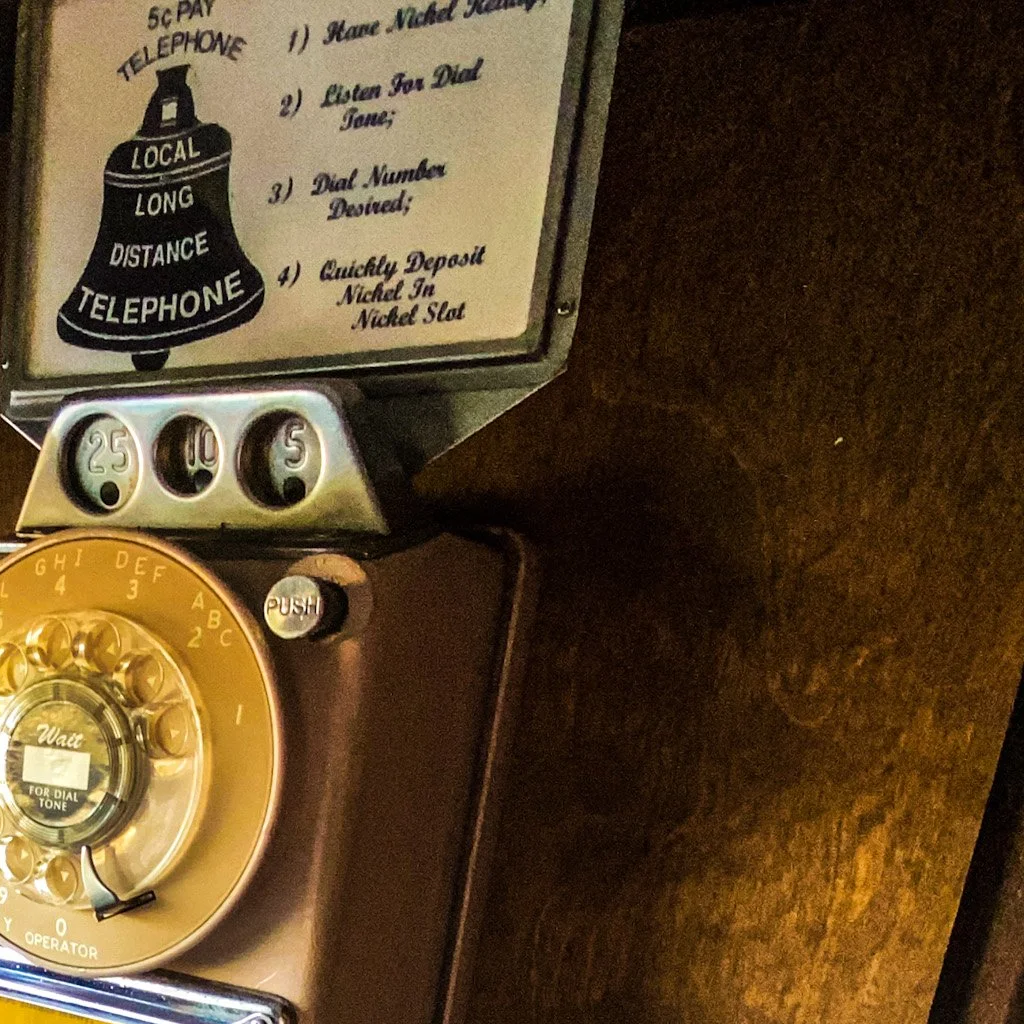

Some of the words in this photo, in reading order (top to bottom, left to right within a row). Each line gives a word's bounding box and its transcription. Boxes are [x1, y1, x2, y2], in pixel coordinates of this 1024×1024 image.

[177, 0, 213, 22] PAY
[288, 24, 310, 54] 1)
[323, 20, 380, 45] Have
[386, 0, 456, 33] Nickel
[117, 29, 247, 81] TELEPHONE
[279, 88, 303, 118] 2)
[320, 83, 382, 108] Listen
[388, 71, 425, 97] For
[431, 56, 484, 89] Dial
[339, 107, 396, 132] Tone;
[131, 136, 201, 169] LOCAL
[268, 176, 294, 205] 3)
[311, 168, 358, 196] Dial
[363, 158, 447, 189] Number
[134, 185, 195, 217] LONG
[327, 189, 414, 221] Desired;
[109, 231, 209, 268] DISTANCE
[277, 260, 302, 288] 4)
[319, 254, 398, 282] Quickly
[404, 245, 486, 277] Deposit
[78, 269, 246, 325] TELEPHONE
[336, 280, 404, 306] Nickel
[408, 277, 435, 300] In
[351, 304, 419, 330] Nickel
[423, 301, 466, 324] Slot
[87, 428, 131, 474] 25
[186, 424, 218, 468] 10
[284, 419, 308, 471] 5
[54, 574, 67, 597] 4
[126, 578, 139, 600] 3
[267, 595, 321, 622] PUSH
[186, 626, 203, 649] 2
[36, 723, 84, 749] Wait
[29, 785, 50, 798] FOR
[54, 789, 79, 803] DIAL
[39, 798, 68, 811] TONE
[24, 931, 98, 961] OPERATOR
